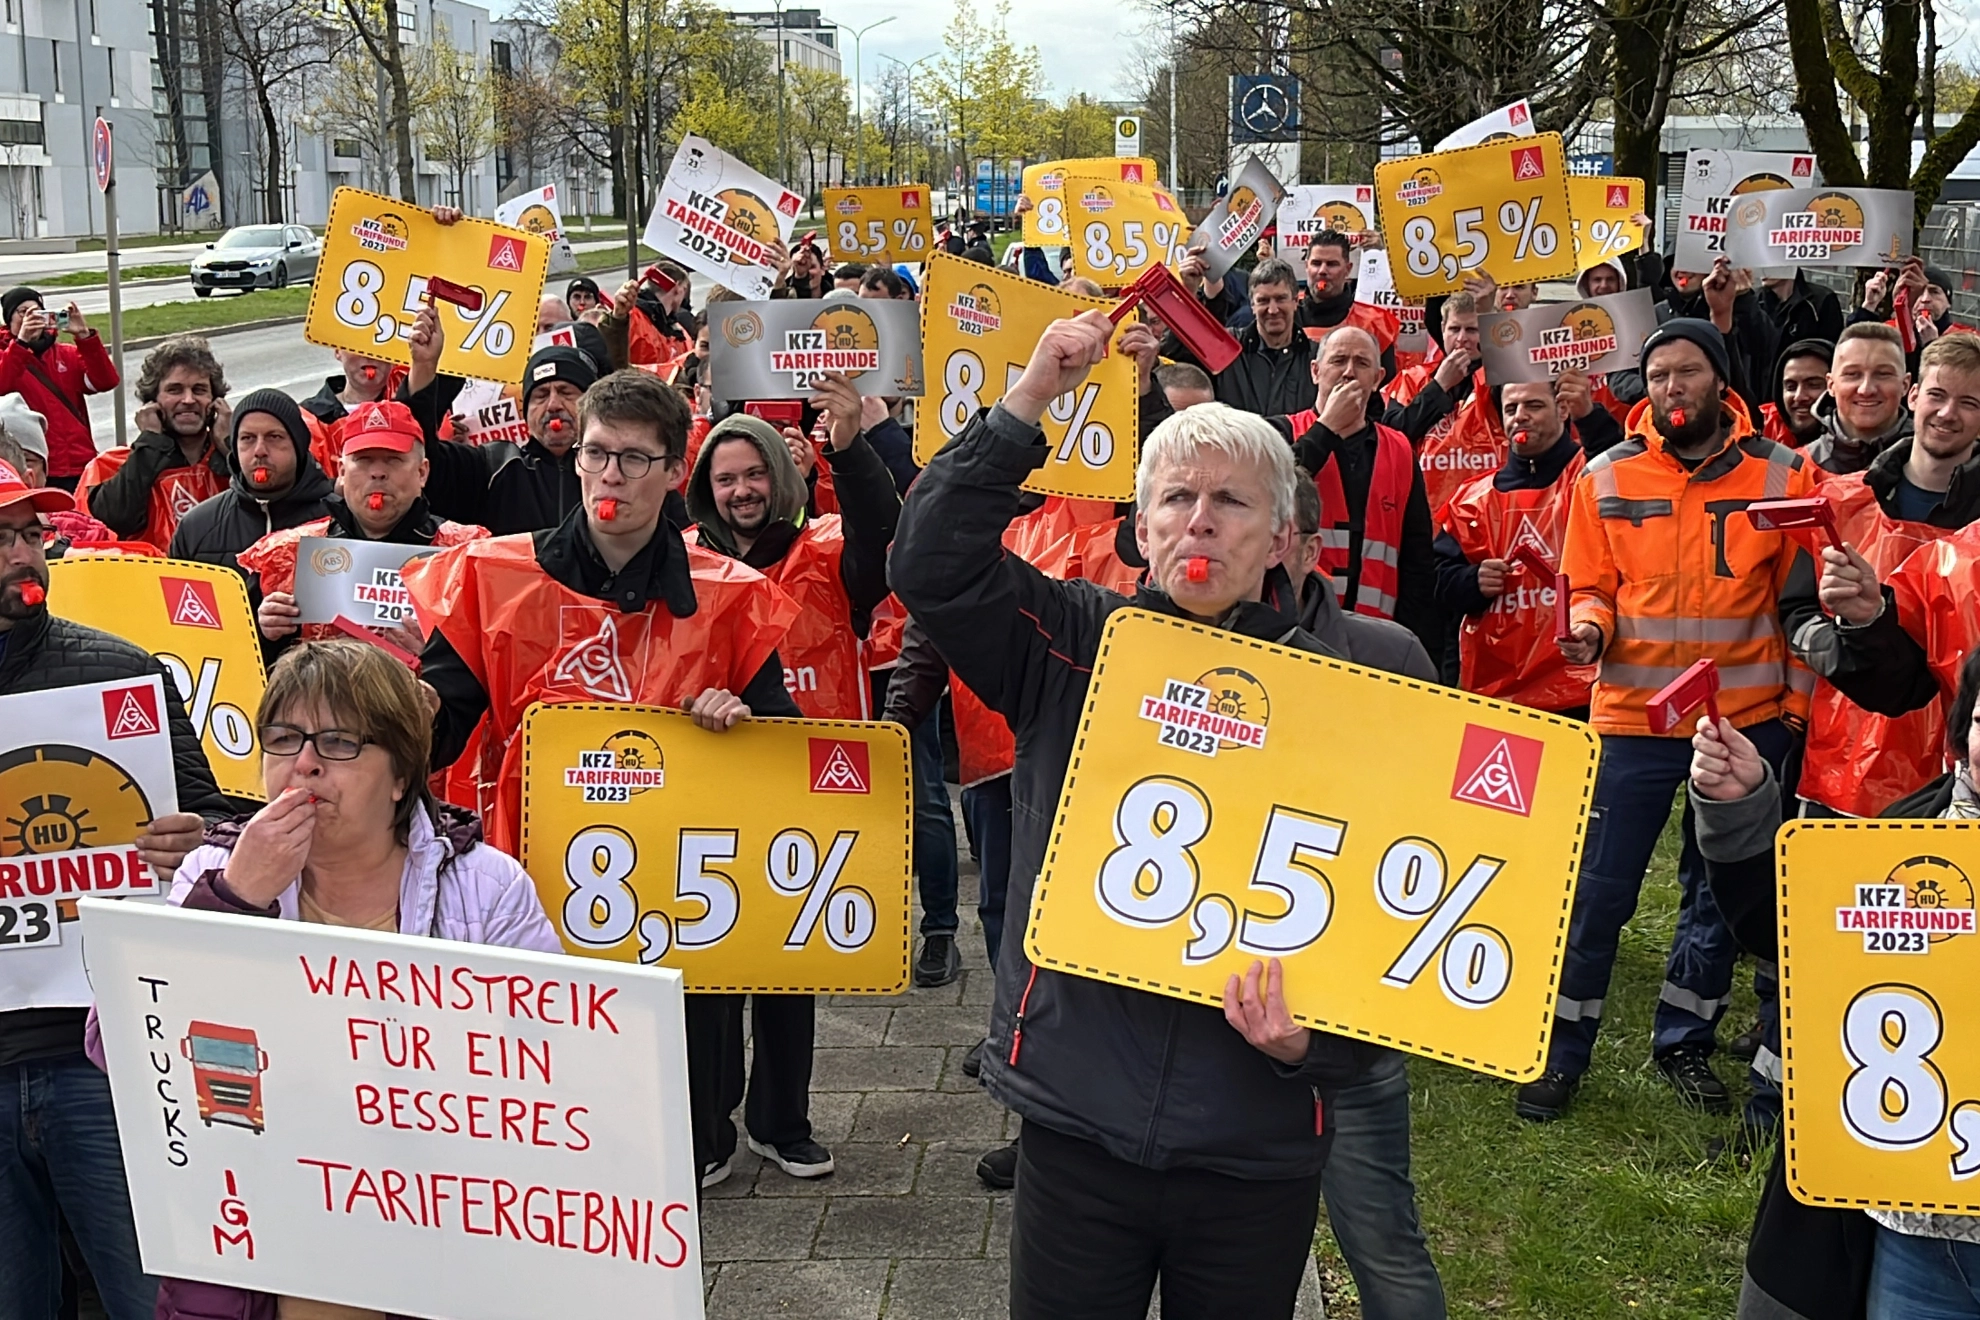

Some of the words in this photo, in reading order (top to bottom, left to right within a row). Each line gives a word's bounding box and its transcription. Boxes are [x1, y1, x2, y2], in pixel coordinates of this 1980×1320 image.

[688, 158, 698, 168] 23
[1698, 168, 1708, 177] 23
[1397, 186, 1442, 199] TARIFRUNDE
[1403, 182, 1417, 190] KFZ
[688, 190, 724, 220] KFZ
[1407, 197, 1426, 206] 2023
[1707, 197, 1731, 214] KF
[362, 219, 380, 231] KFZ
[737, 219, 751, 232] HU
[1037, 197, 1070, 240] 8,
[1221, 199, 1263, 248] TARIFRUNDE
[1222, 214, 1239, 234] KFZ
[1297, 220, 1323, 232] KFZ
[1785, 215, 1814, 228] KFZ
[352, 226, 406, 248] TARIFRUNDE
[666, 198, 769, 267] TARIFRUNDE
[838, 219, 887, 256] 8,5
[893, 217, 925, 251] %
[1236, 223, 1258, 248] 2023
[1403, 206, 1489, 281] 8,5
[1498, 196, 1558, 262] %
[1590, 219, 1630, 255] %
[1771, 230, 1862, 244] TARIFRUNDE
[361, 238, 385, 252] 2023
[679, 227, 728, 264] 2023
[1084, 221, 1149, 276] 8,5
[1153, 222, 1188, 266] %
[1788, 245, 1828, 258] 2023
[336, 259, 432, 344] 8,5
[457, 284, 515, 355] %
[958, 294, 975, 309] KFZ
[1374, 291, 1400, 306] KFZ
[949, 305, 1000, 329] TARIFRUNDE
[959, 319, 982, 335] 2023
[735, 321, 754, 336] ABS
[1400, 322, 1417, 334] 23
[1543, 329, 1571, 345] KFZ
[789, 333, 823, 350] KFZ
[838, 337, 851, 346] HU
[1530, 337, 1616, 362] TARIFRUNDE
[772, 352, 878, 370] TARIFRUNDE
[478, 402, 515, 428] KFZ
[468, 423, 531, 447] TARIFR
[1419, 447, 1497, 472] treiken
[323, 555, 342, 566] ABS
[376, 571, 406, 588] KF
[357, 586, 411, 605] TARIF
[1505, 584, 1557, 614] stre
[377, 604, 414, 621] 202
[1166, 682, 1206, 708] KFZ
[1221, 702, 1235, 714] HU
[1144, 698, 1263, 745] TARIFRUNDE
[1162, 725, 1215, 754] 2023
[582, 754, 611, 768] KFZ
[625, 758, 636, 767] HU
[567, 770, 662, 786] TARIFRUNDE
[586, 787, 627, 802] 2023
[33, 822, 67, 845] HU
[0, 850, 153, 898] RUNDE
[562, 824, 741, 965] 8,5
[766, 827, 877, 952] %
[1095, 774, 1349, 966] 8,5
[1374, 835, 1514, 1009] %
[1860, 888, 1901, 907] KFZ
[1920, 894, 1936, 905] HU
[0, 902, 51, 944] 23
[1839, 909, 1973, 931] TARIFRUNDE
[1868, 932, 1925, 952] 2023
[299, 955, 620, 1034] WARNSTREIK
[347, 1017, 436, 1071] FÜR
[467, 1031, 551, 1085] EIN
[138, 976, 189, 1167] TRUCKS
[1841, 982, 1980, 1181] 8,
[355, 1084, 591, 1151] BESSERES
[213, 1169, 255, 1260] IGM
[297, 1158, 689, 1269] TARIFERGEBNIS
